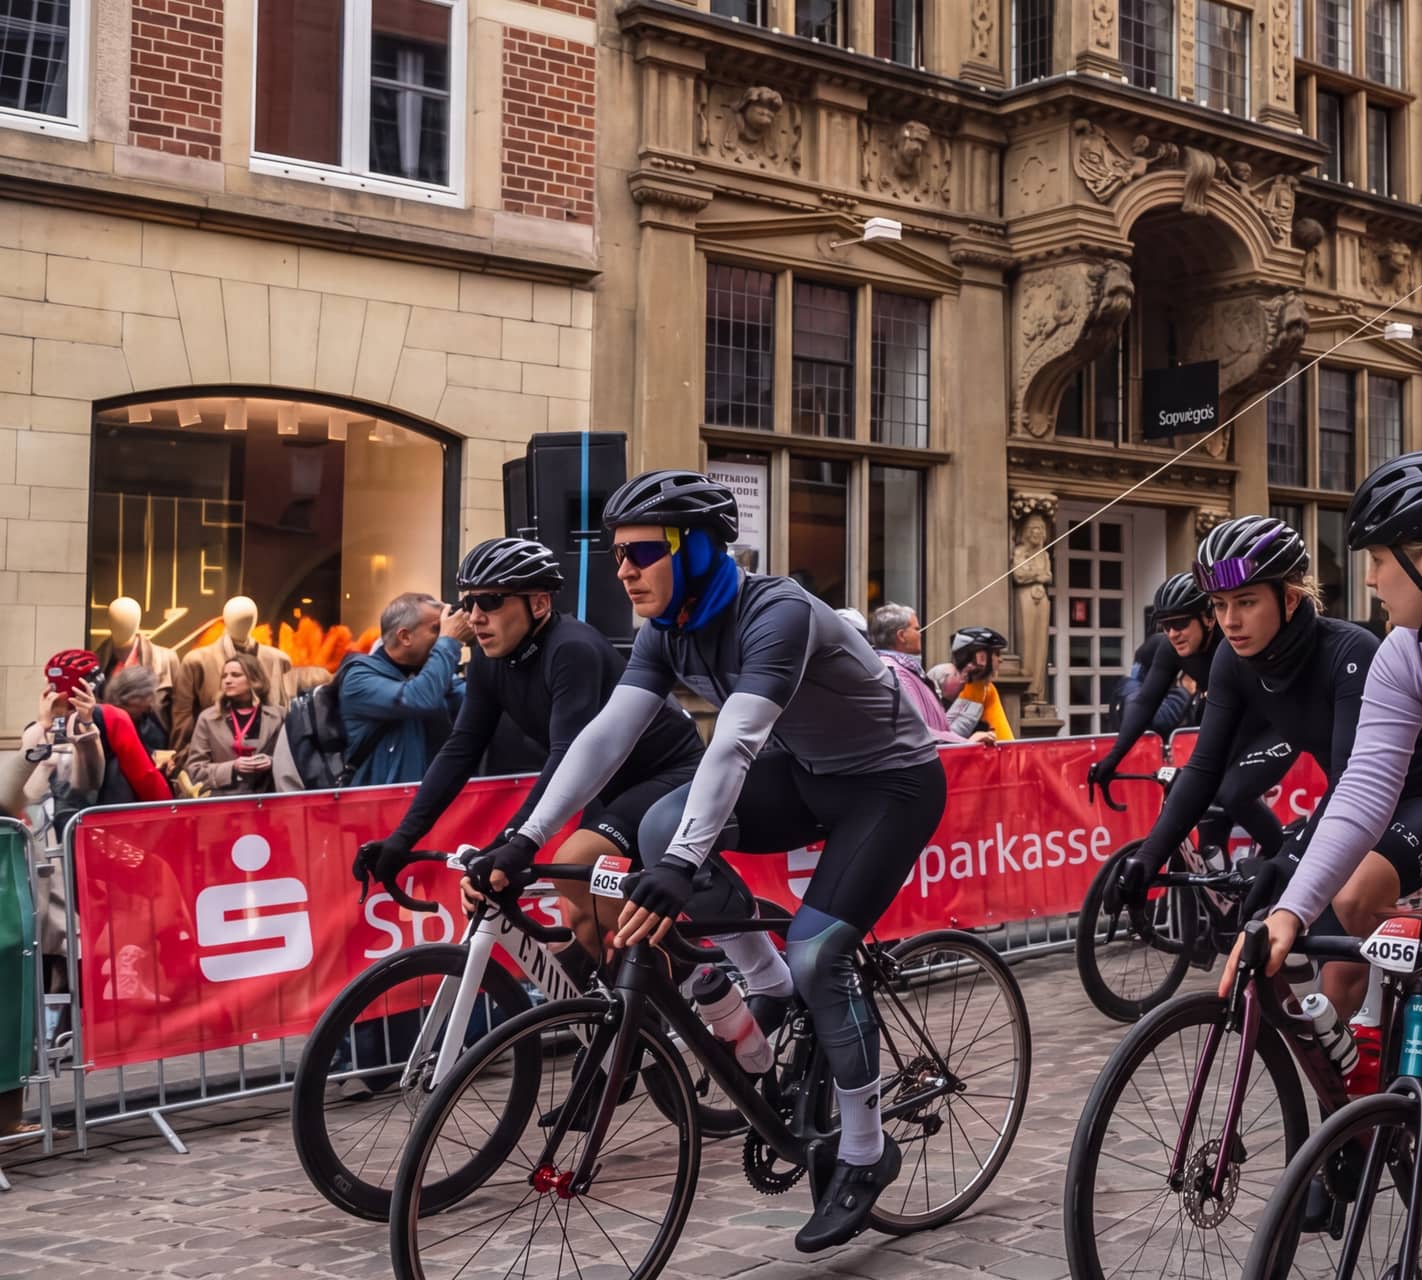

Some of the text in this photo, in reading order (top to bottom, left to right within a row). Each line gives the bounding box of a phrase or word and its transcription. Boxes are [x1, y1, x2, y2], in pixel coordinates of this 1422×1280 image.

[902, 822, 1112, 898] parkasse
[593, 873, 622, 891] 605
[1366, 941, 1416, 962] 4056
